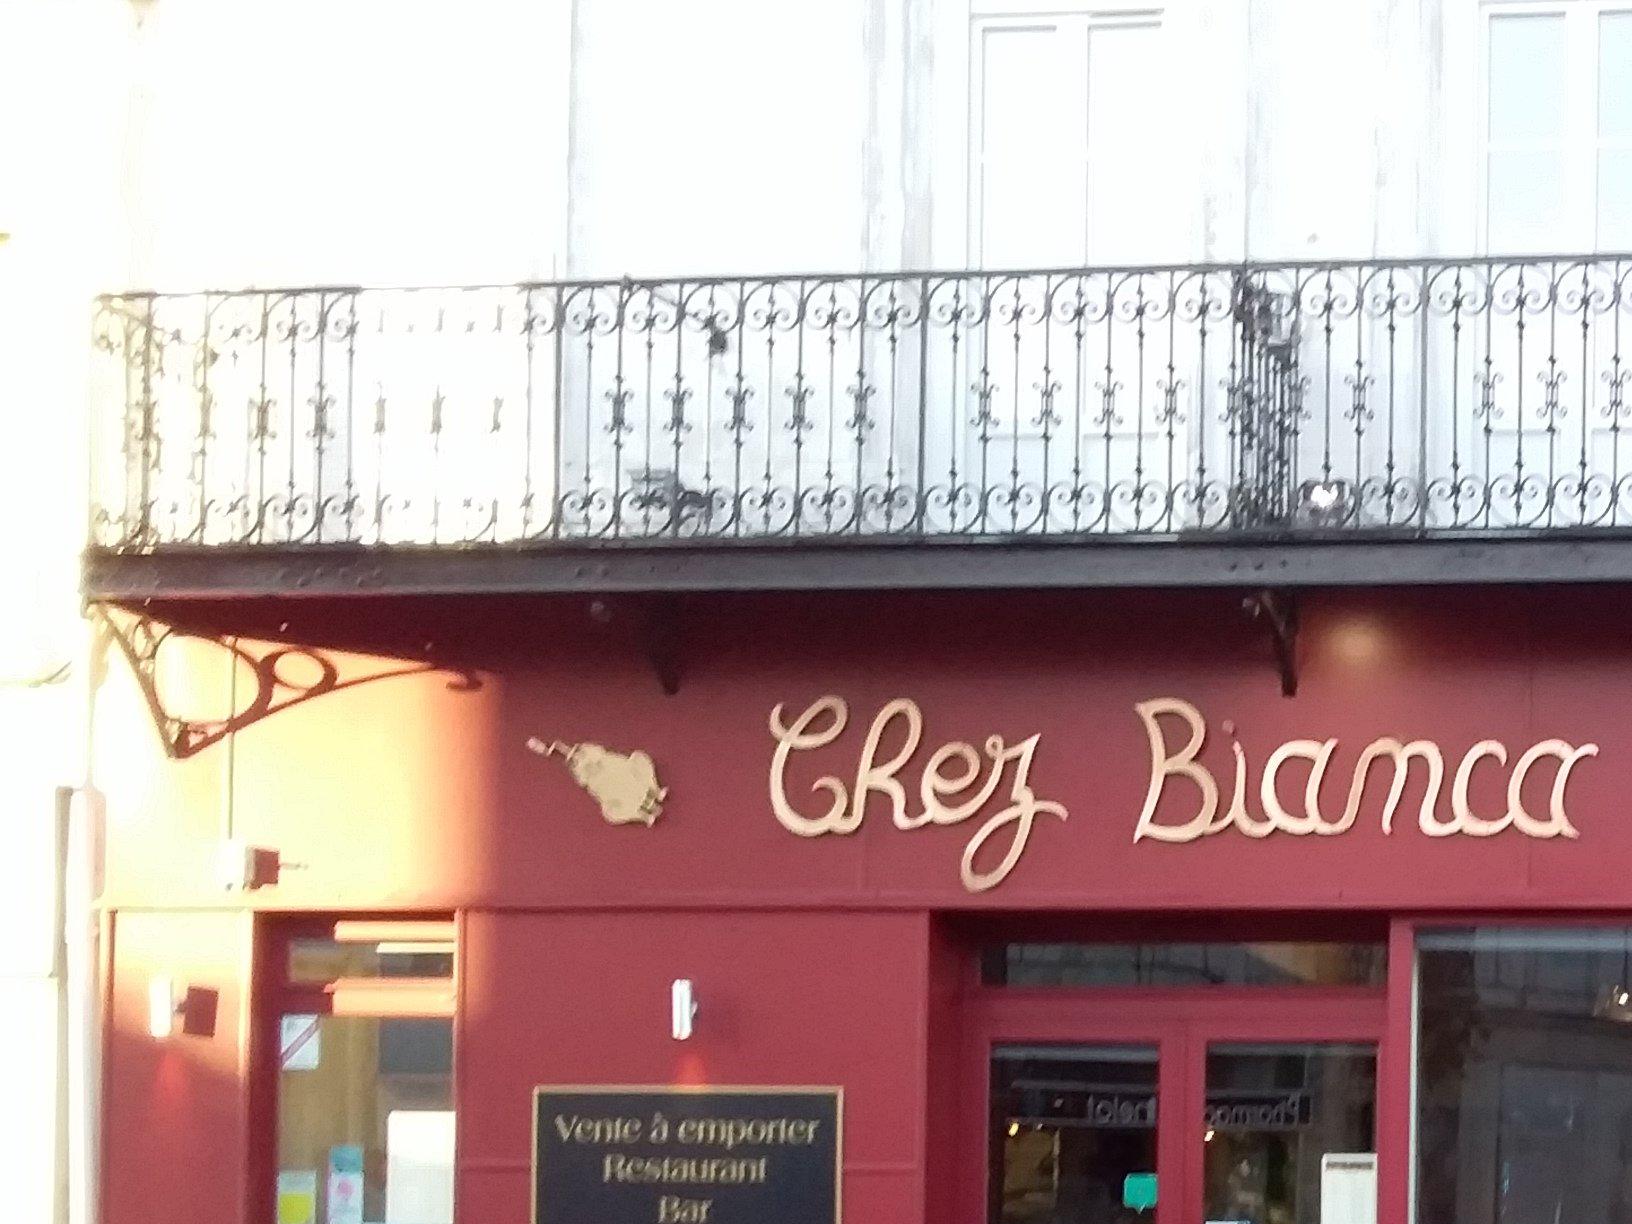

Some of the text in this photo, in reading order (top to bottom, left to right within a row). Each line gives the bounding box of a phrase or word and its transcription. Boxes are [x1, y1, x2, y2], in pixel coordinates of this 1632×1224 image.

[769, 694, 1069, 893] Chez
[1133, 696, 1600, 844] Bianca
[554, 1110, 821, 1150] Vente à emporter
[603, 1152, 767, 1184] Restaurant
[657, 1195, 712, 1224] Bar
